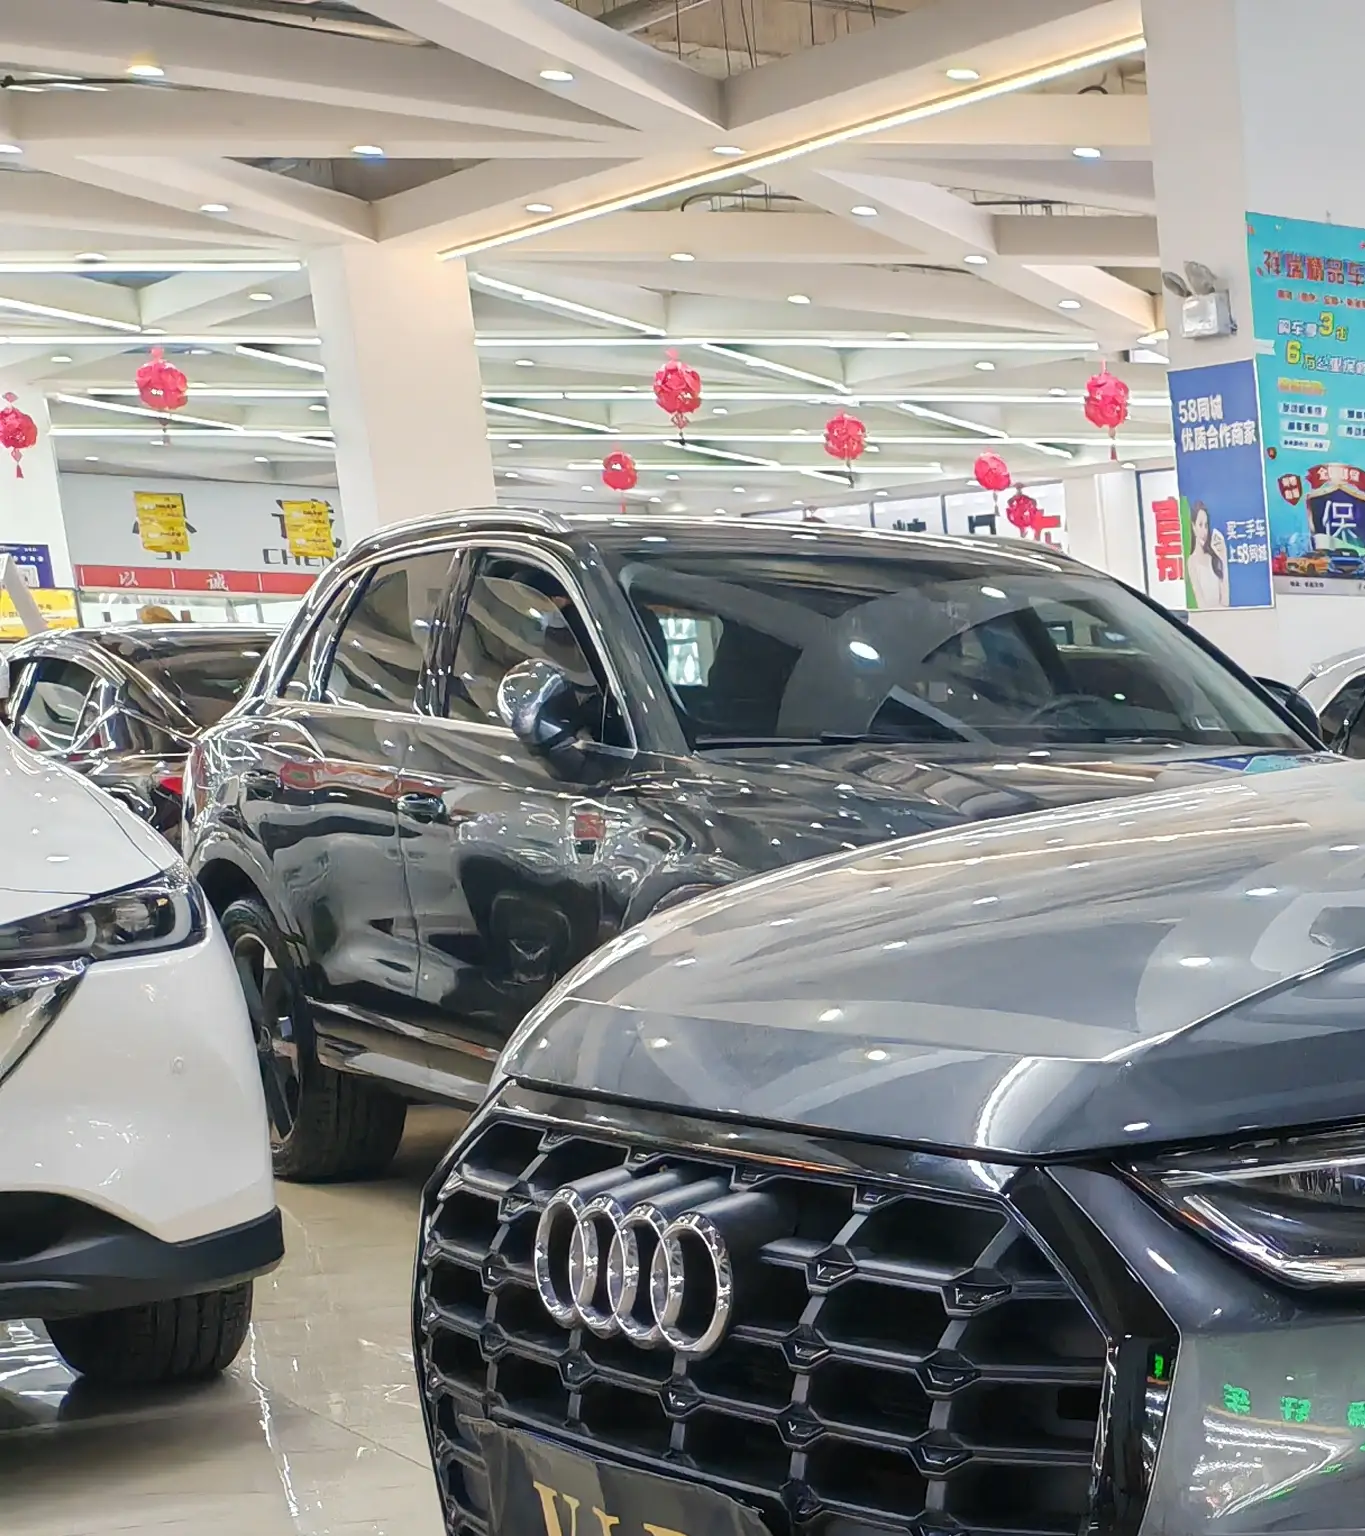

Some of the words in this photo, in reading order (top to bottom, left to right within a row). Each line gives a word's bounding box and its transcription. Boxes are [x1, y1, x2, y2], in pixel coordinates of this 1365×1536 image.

[1178, 394, 1224, 424] 58同城
[1181, 419, 1258, 453] 优质合作商家
